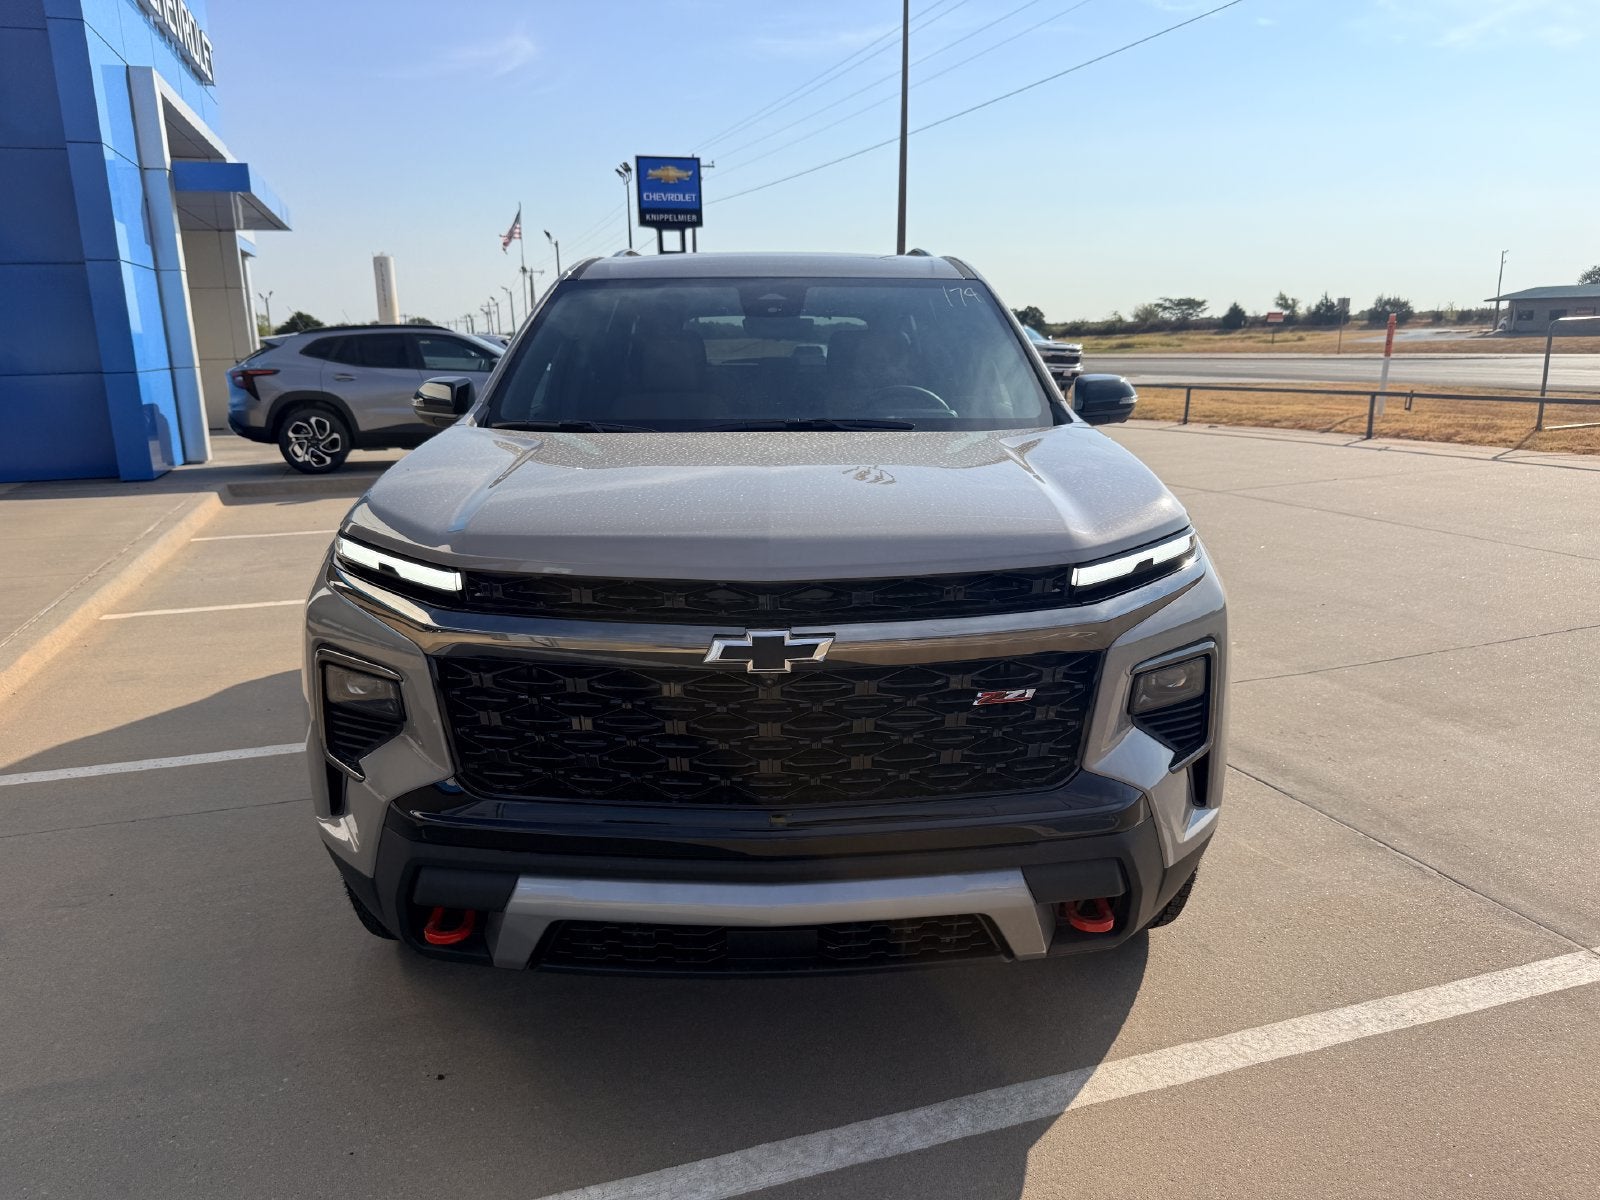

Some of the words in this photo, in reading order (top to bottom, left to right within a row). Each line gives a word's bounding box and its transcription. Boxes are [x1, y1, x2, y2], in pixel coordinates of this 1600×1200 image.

[643, 192, 696, 202] CHEVROLET
[645, 213, 697, 222] KNIPPELMIER
[972, 688, 1037, 706] Z71
